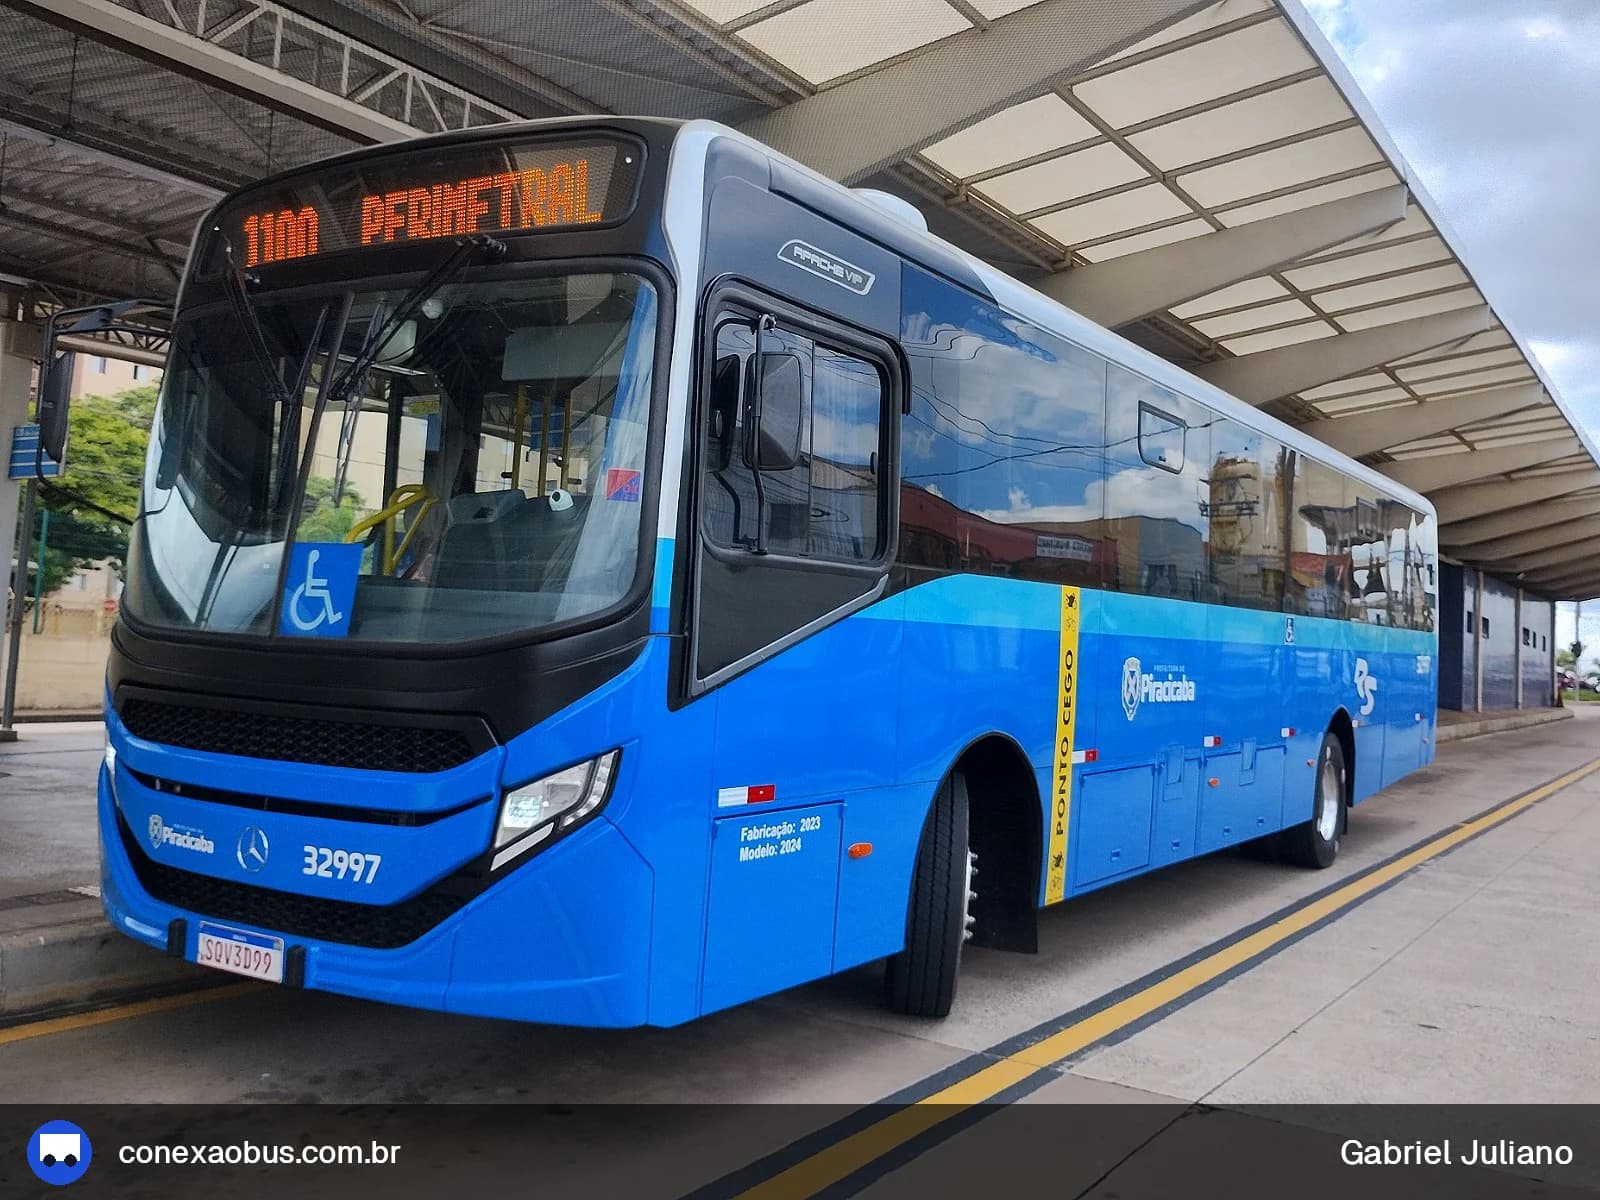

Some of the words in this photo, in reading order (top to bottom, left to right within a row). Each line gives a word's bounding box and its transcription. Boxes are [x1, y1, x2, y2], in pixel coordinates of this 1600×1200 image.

[243, 204, 320, 268] 1100
[793, 245, 845, 278] APACHE
[844, 268, 863, 285] VIP
[1062, 649, 1075, 726] CEGO
[1140, 673, 1196, 703] Piracicaba
[1056, 736, 1069, 836] PONTO
[162, 826, 215, 854] Piracicaba
[740, 821, 796, 842] Fabricação:
[800, 816, 821, 832] 2023
[303, 845, 382, 884] 32997
[739, 843, 778, 861] Modelo:
[779, 837, 801, 855] 2024
